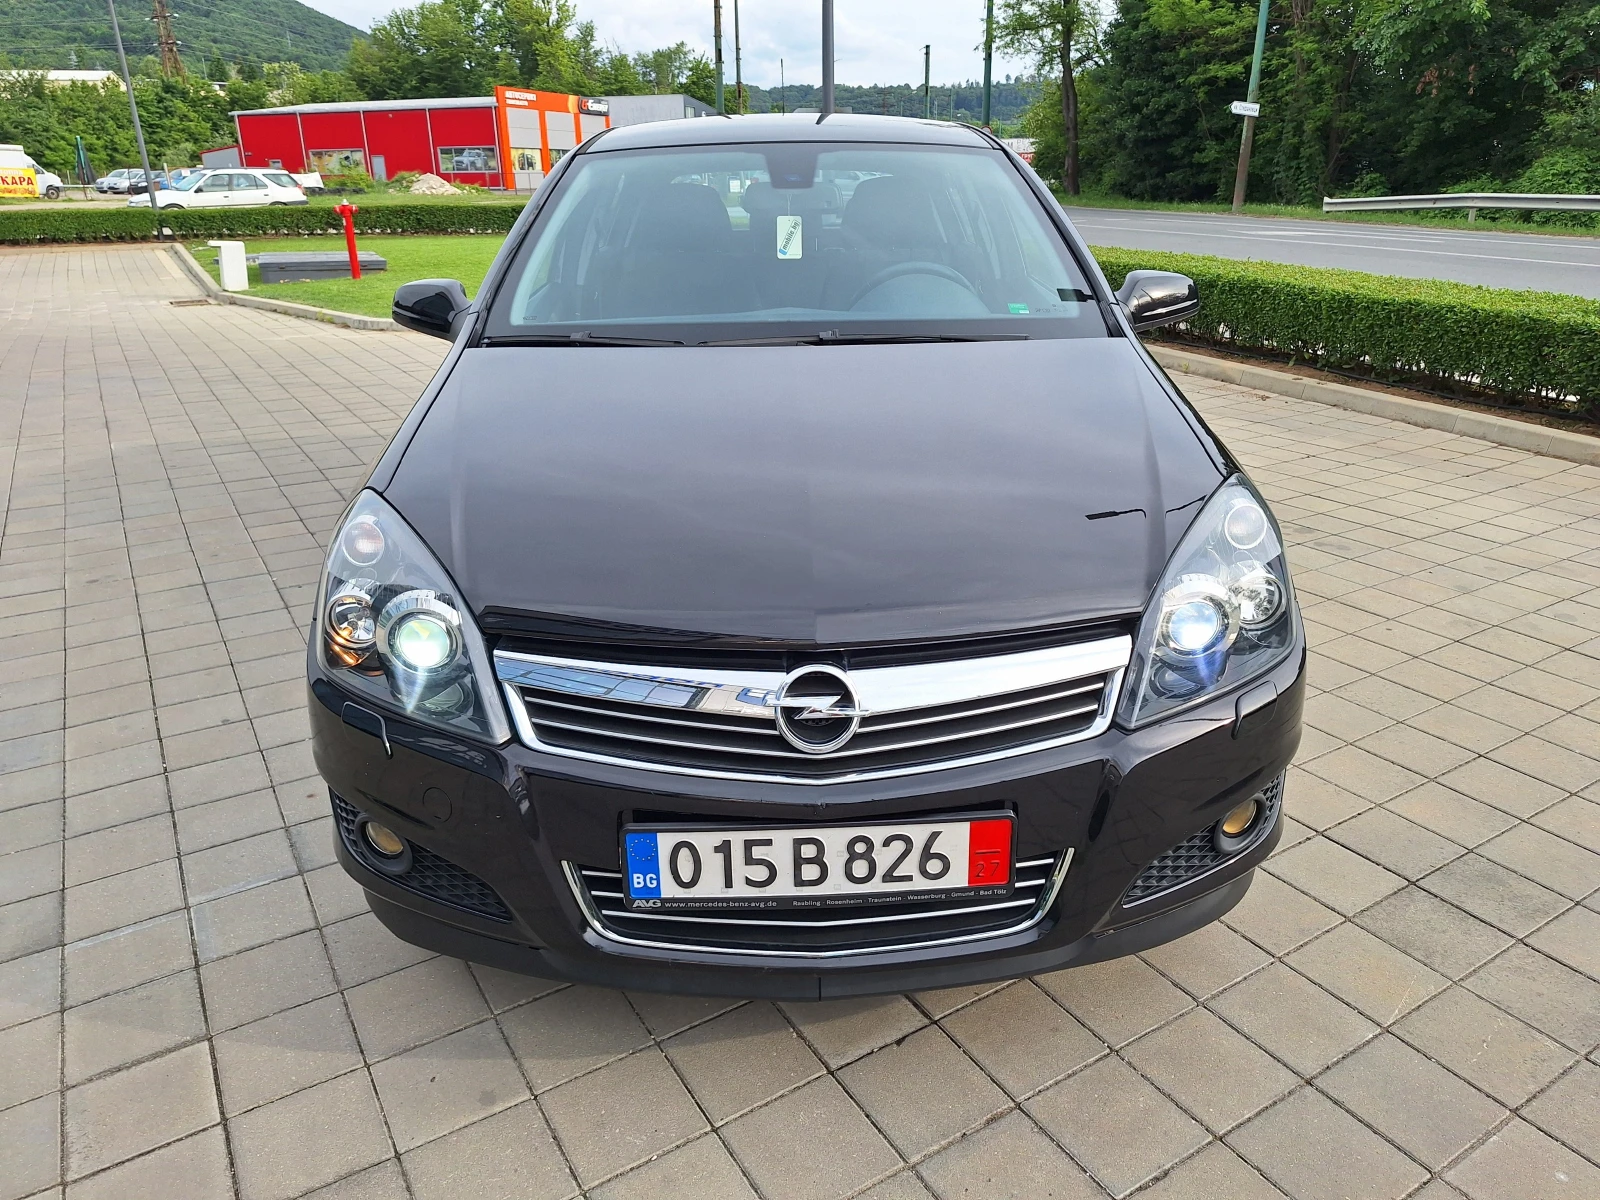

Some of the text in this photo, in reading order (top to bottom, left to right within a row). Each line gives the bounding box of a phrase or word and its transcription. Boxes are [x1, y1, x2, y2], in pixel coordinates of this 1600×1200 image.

[0, 175, 34, 186] КАРА
[669, 831, 952, 889] 015 B 826
[975, 860, 1001, 878] 27
[632, 873, 658, 889] BG
[632, 899, 777, 909] AVG www.mercedes-benz-avg.de
[793, 900, 821, 908] Raubling
[826, 898, 863, 906] Rosenheim
[868, 896, 902, 904] Traunstein
[907, 893, 946, 902] Wasserburg
[951, 891, 975, 899] Gmund
[993, 888, 1007, 896] Tölz
